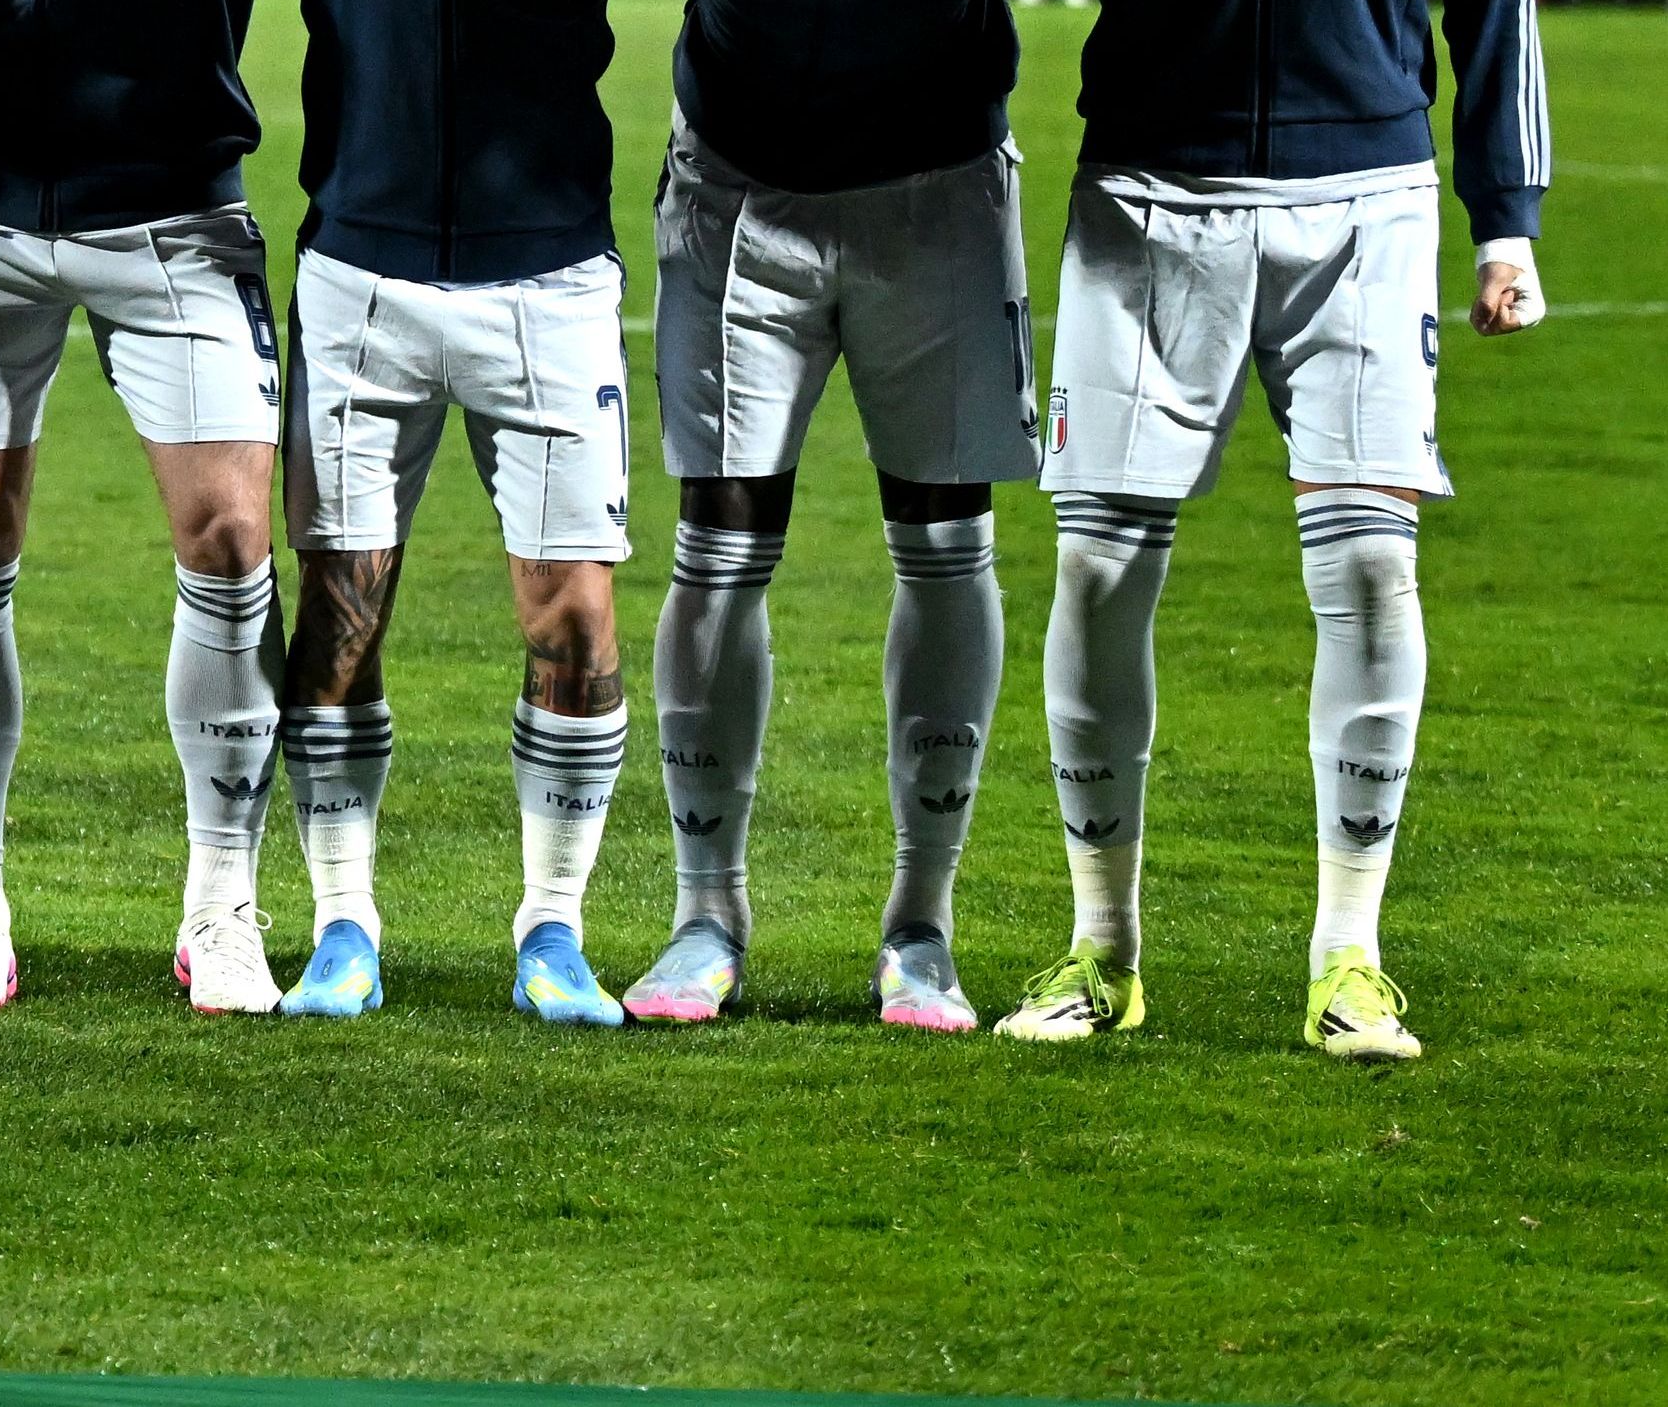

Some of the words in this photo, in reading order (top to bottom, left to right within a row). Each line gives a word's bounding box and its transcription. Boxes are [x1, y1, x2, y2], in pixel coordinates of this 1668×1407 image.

[596, 384, 627, 476] 7
[914, 733, 979, 754] ITALIA
[1339, 760, 1408, 782] ITALIA
[297, 796, 362, 816] ITALIA
